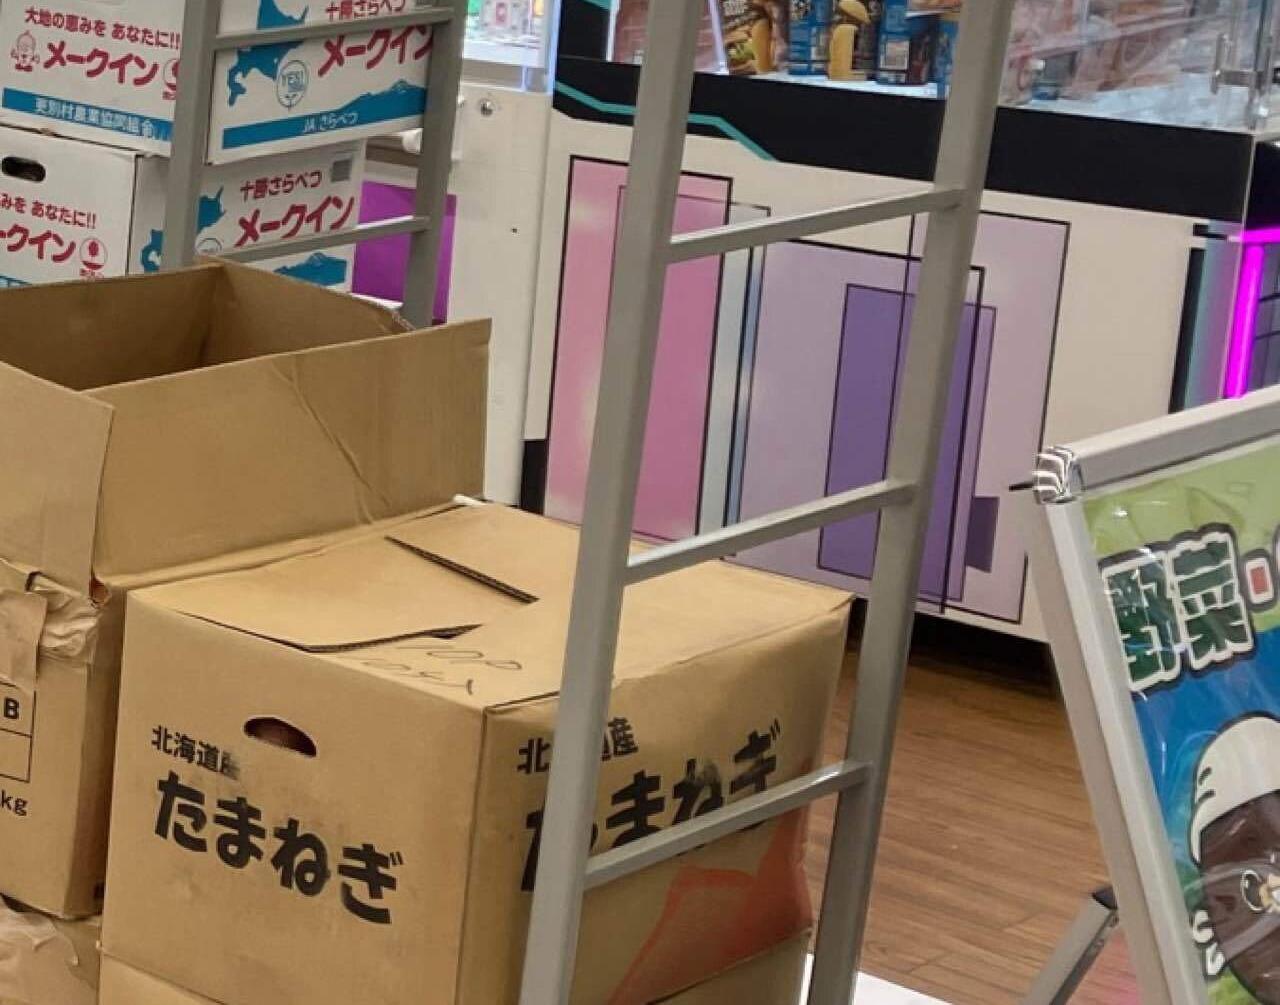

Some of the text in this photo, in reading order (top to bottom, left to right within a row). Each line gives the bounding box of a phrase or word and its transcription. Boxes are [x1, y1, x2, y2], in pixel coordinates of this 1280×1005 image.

[24, 7, 181, 51] 大地の恵みを あなたに!!
[317, 24, 435, 79] メークイン
[43, 40, 159, 87] メークイン
[31, 199, 97, 230] あなたに!!
[234, 195, 356, 248] メークイン
[4, 698, 20, 719] B
[516, 716, 640, 775] 北産
[155, 770, 404, 925] たまねぎ
